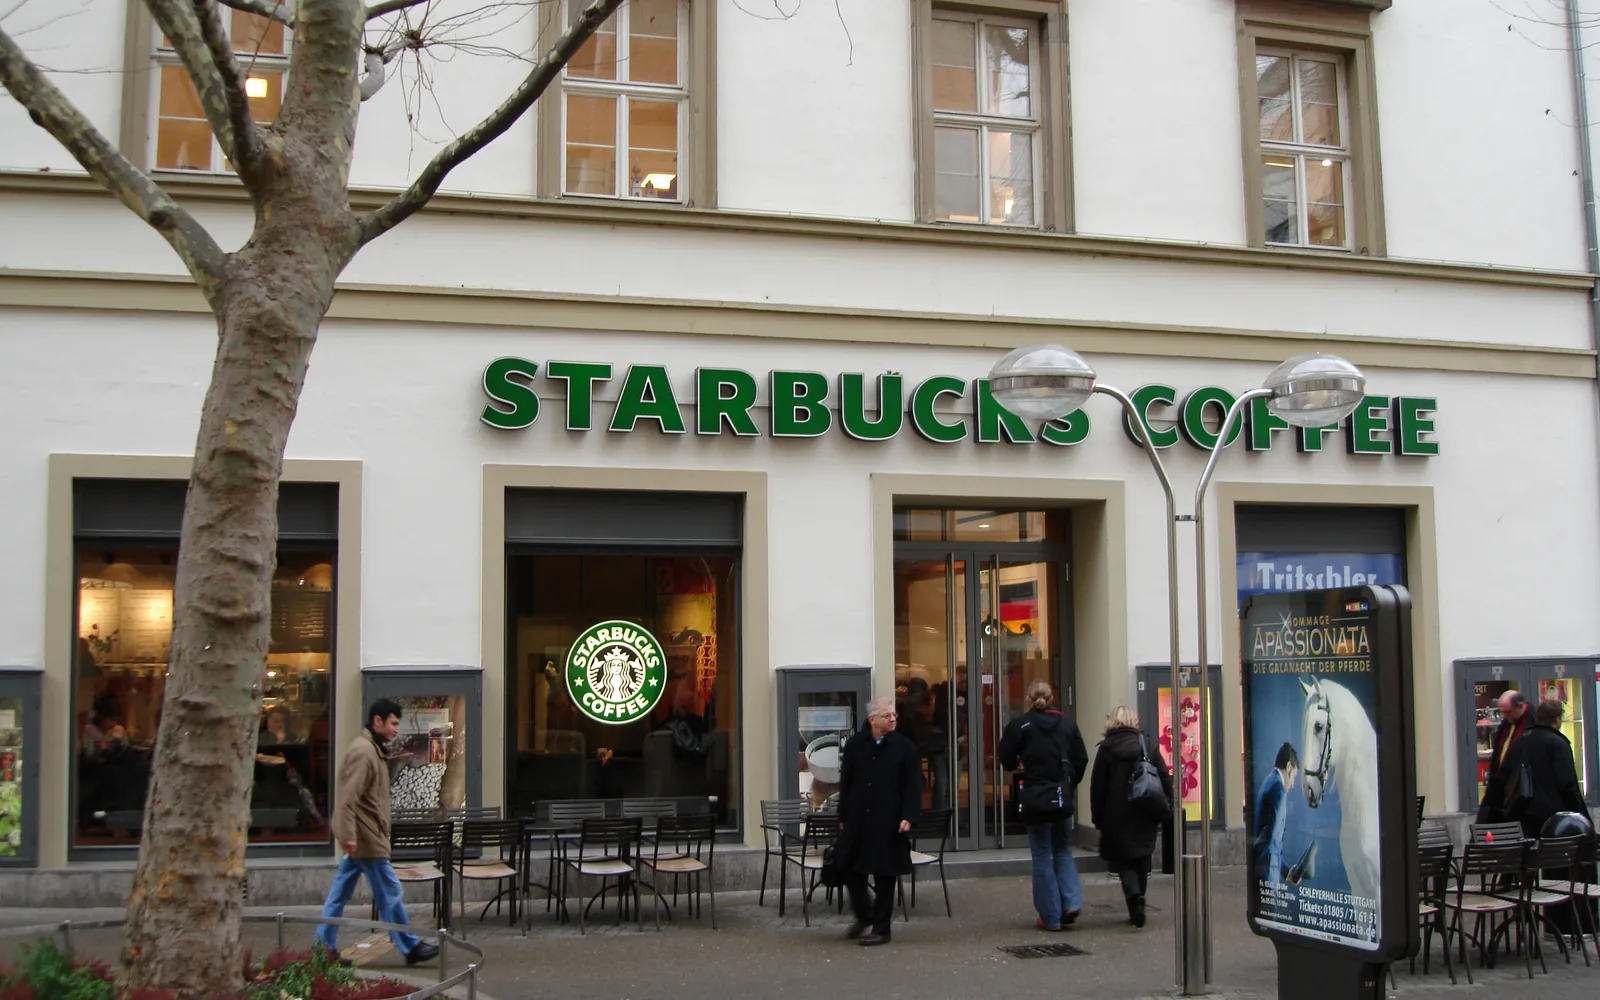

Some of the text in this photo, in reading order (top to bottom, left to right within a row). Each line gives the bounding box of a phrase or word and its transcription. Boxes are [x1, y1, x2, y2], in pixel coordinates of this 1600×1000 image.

[480, 356, 1091, 446] STARBUCKS
[1257, 562, 1377, 590] Tritschler
[573, 626, 660, 668] STARBUCKS
[1252, 626, 1371, 657] APASSIONATA
[1253, 660, 1371, 674] DIE GALANACHT DER PFERDE
[582, 692, 650, 718] COFFEE
[1298, 886, 1377, 909] SCHLEYERHALLE STUTTGART
[1299, 899, 1323, 914] Tickets:
[1323, 904, 1344, 918] 01805
[1349, 909, 1357, 921] 71
[1358, 911, 1367, 923] 61
[1298, 913, 1377, 938] www.apassionata.de
